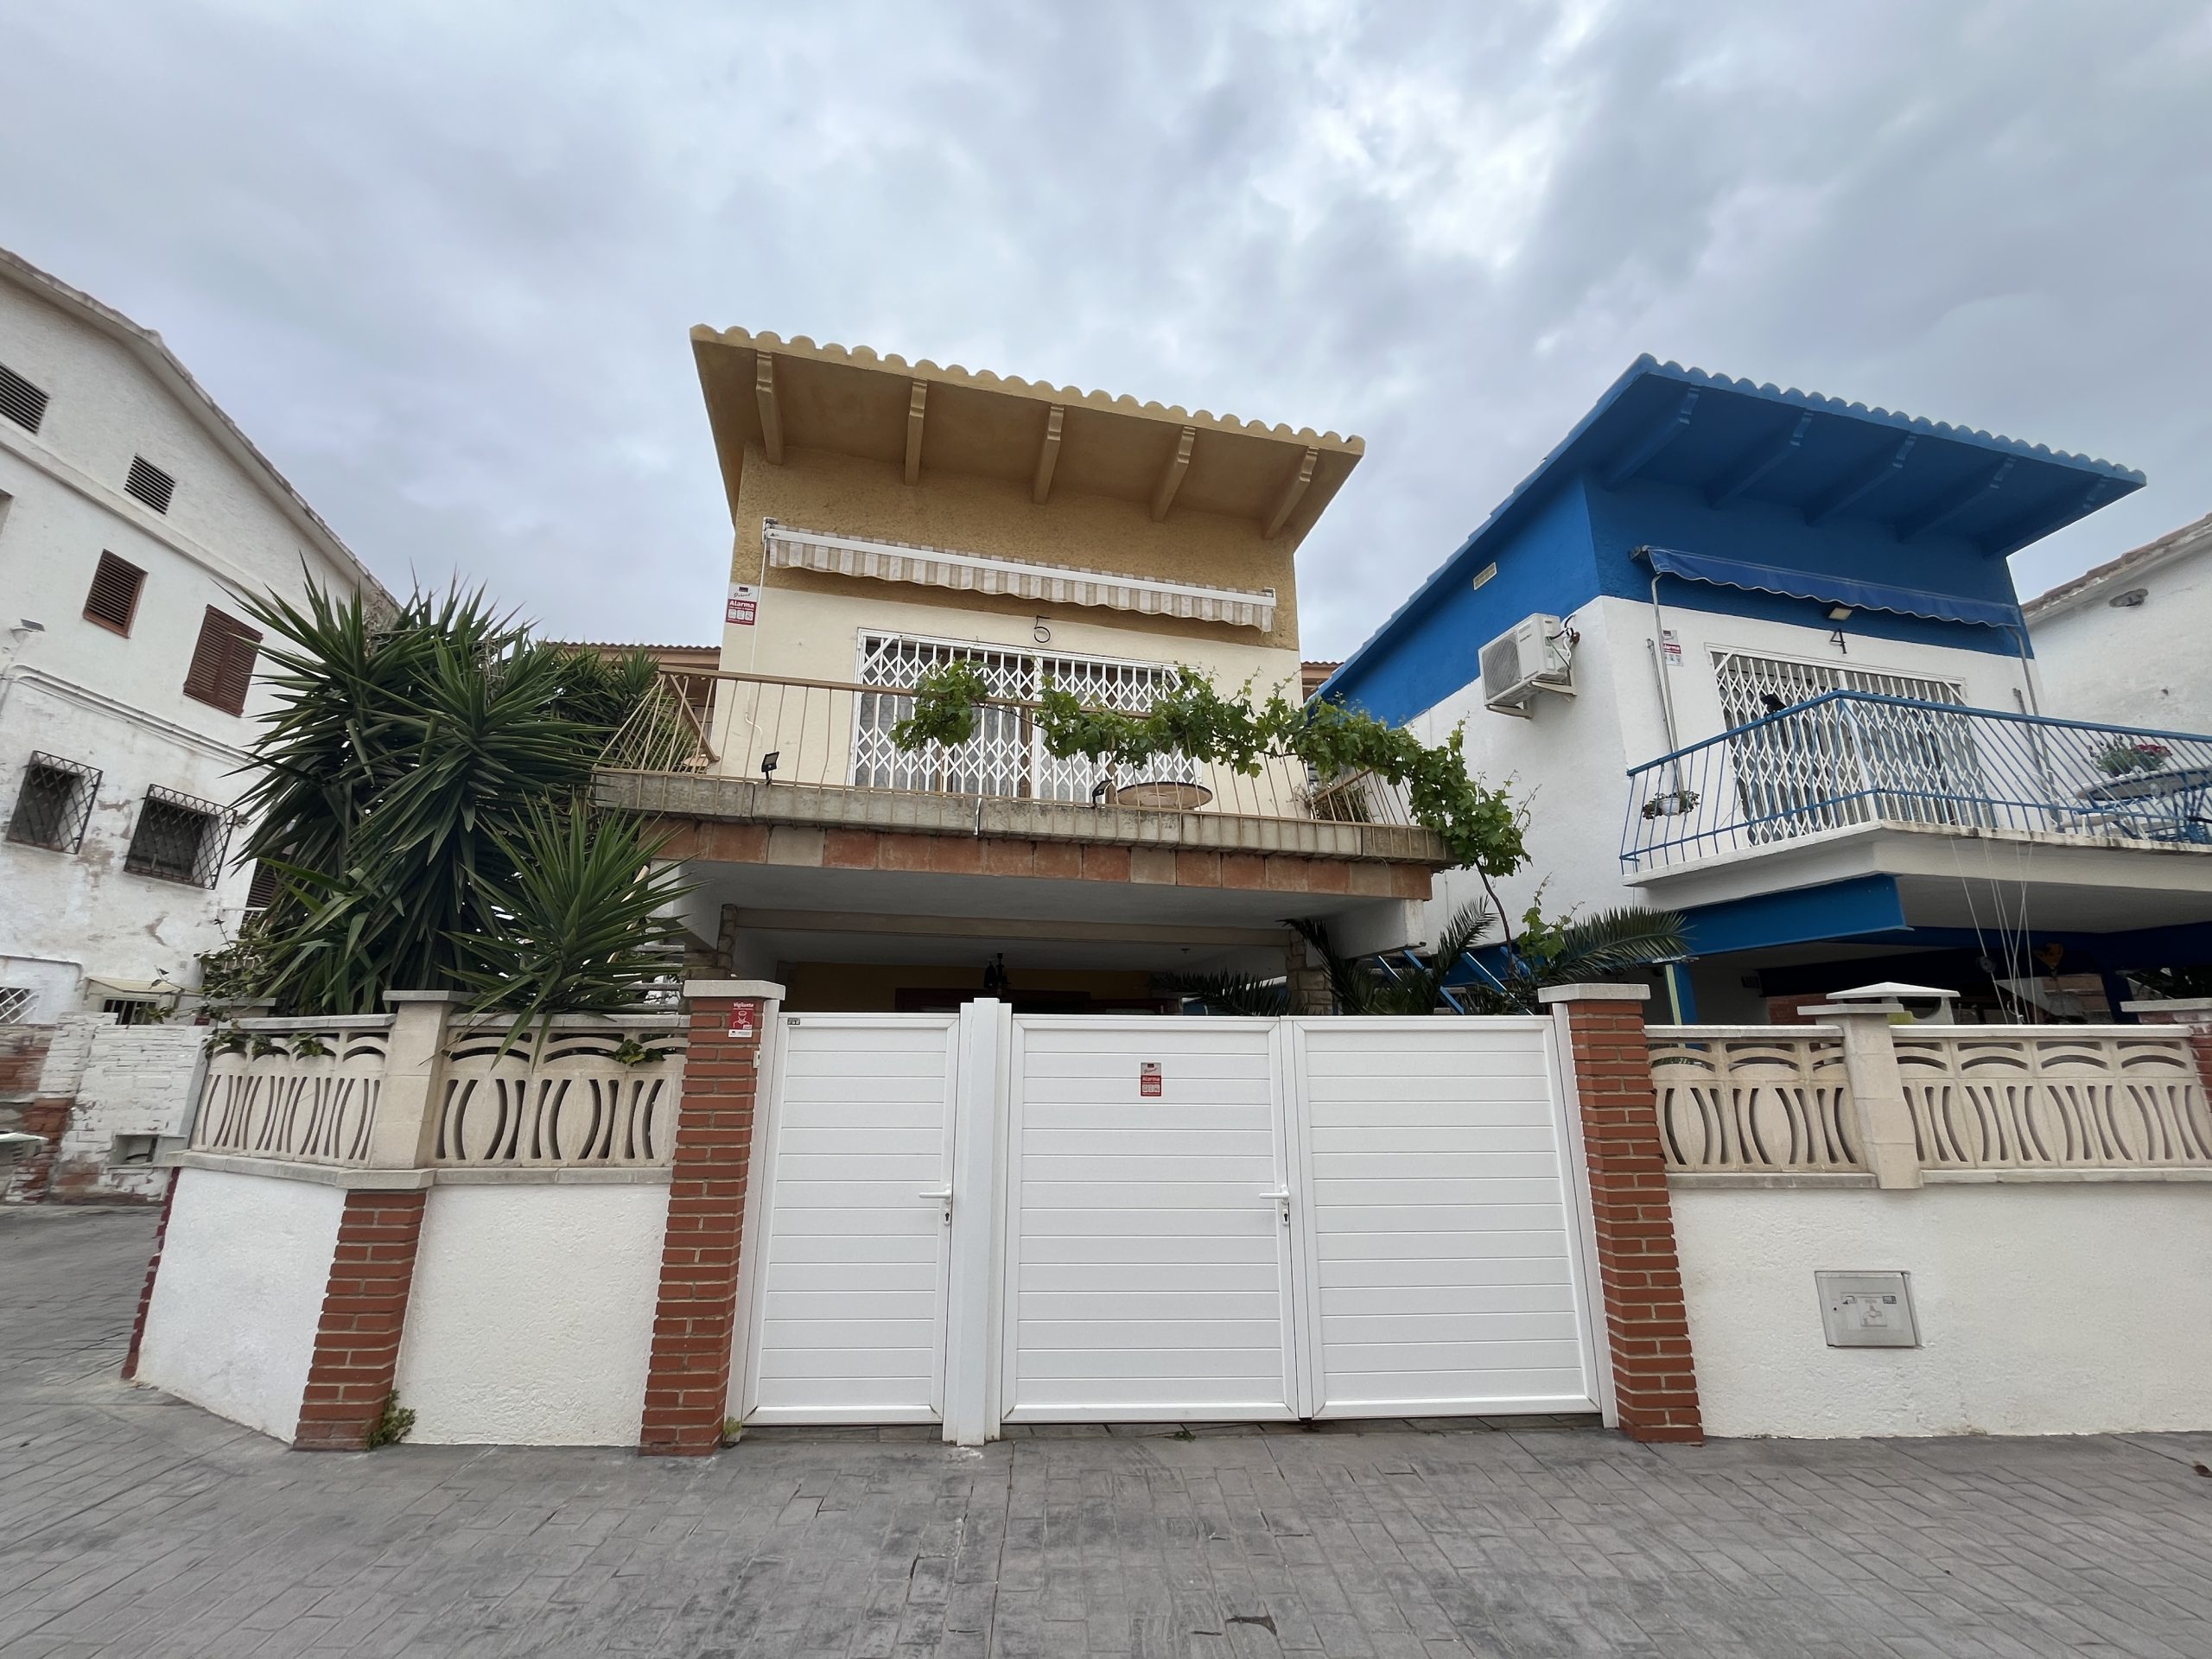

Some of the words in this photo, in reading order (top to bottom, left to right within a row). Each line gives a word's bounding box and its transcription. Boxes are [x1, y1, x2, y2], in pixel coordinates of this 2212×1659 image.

[729, 600, 754, 608] Alarma
[1034, 614, 1051, 643] 5
[1830, 628, 1847, 654] 4
